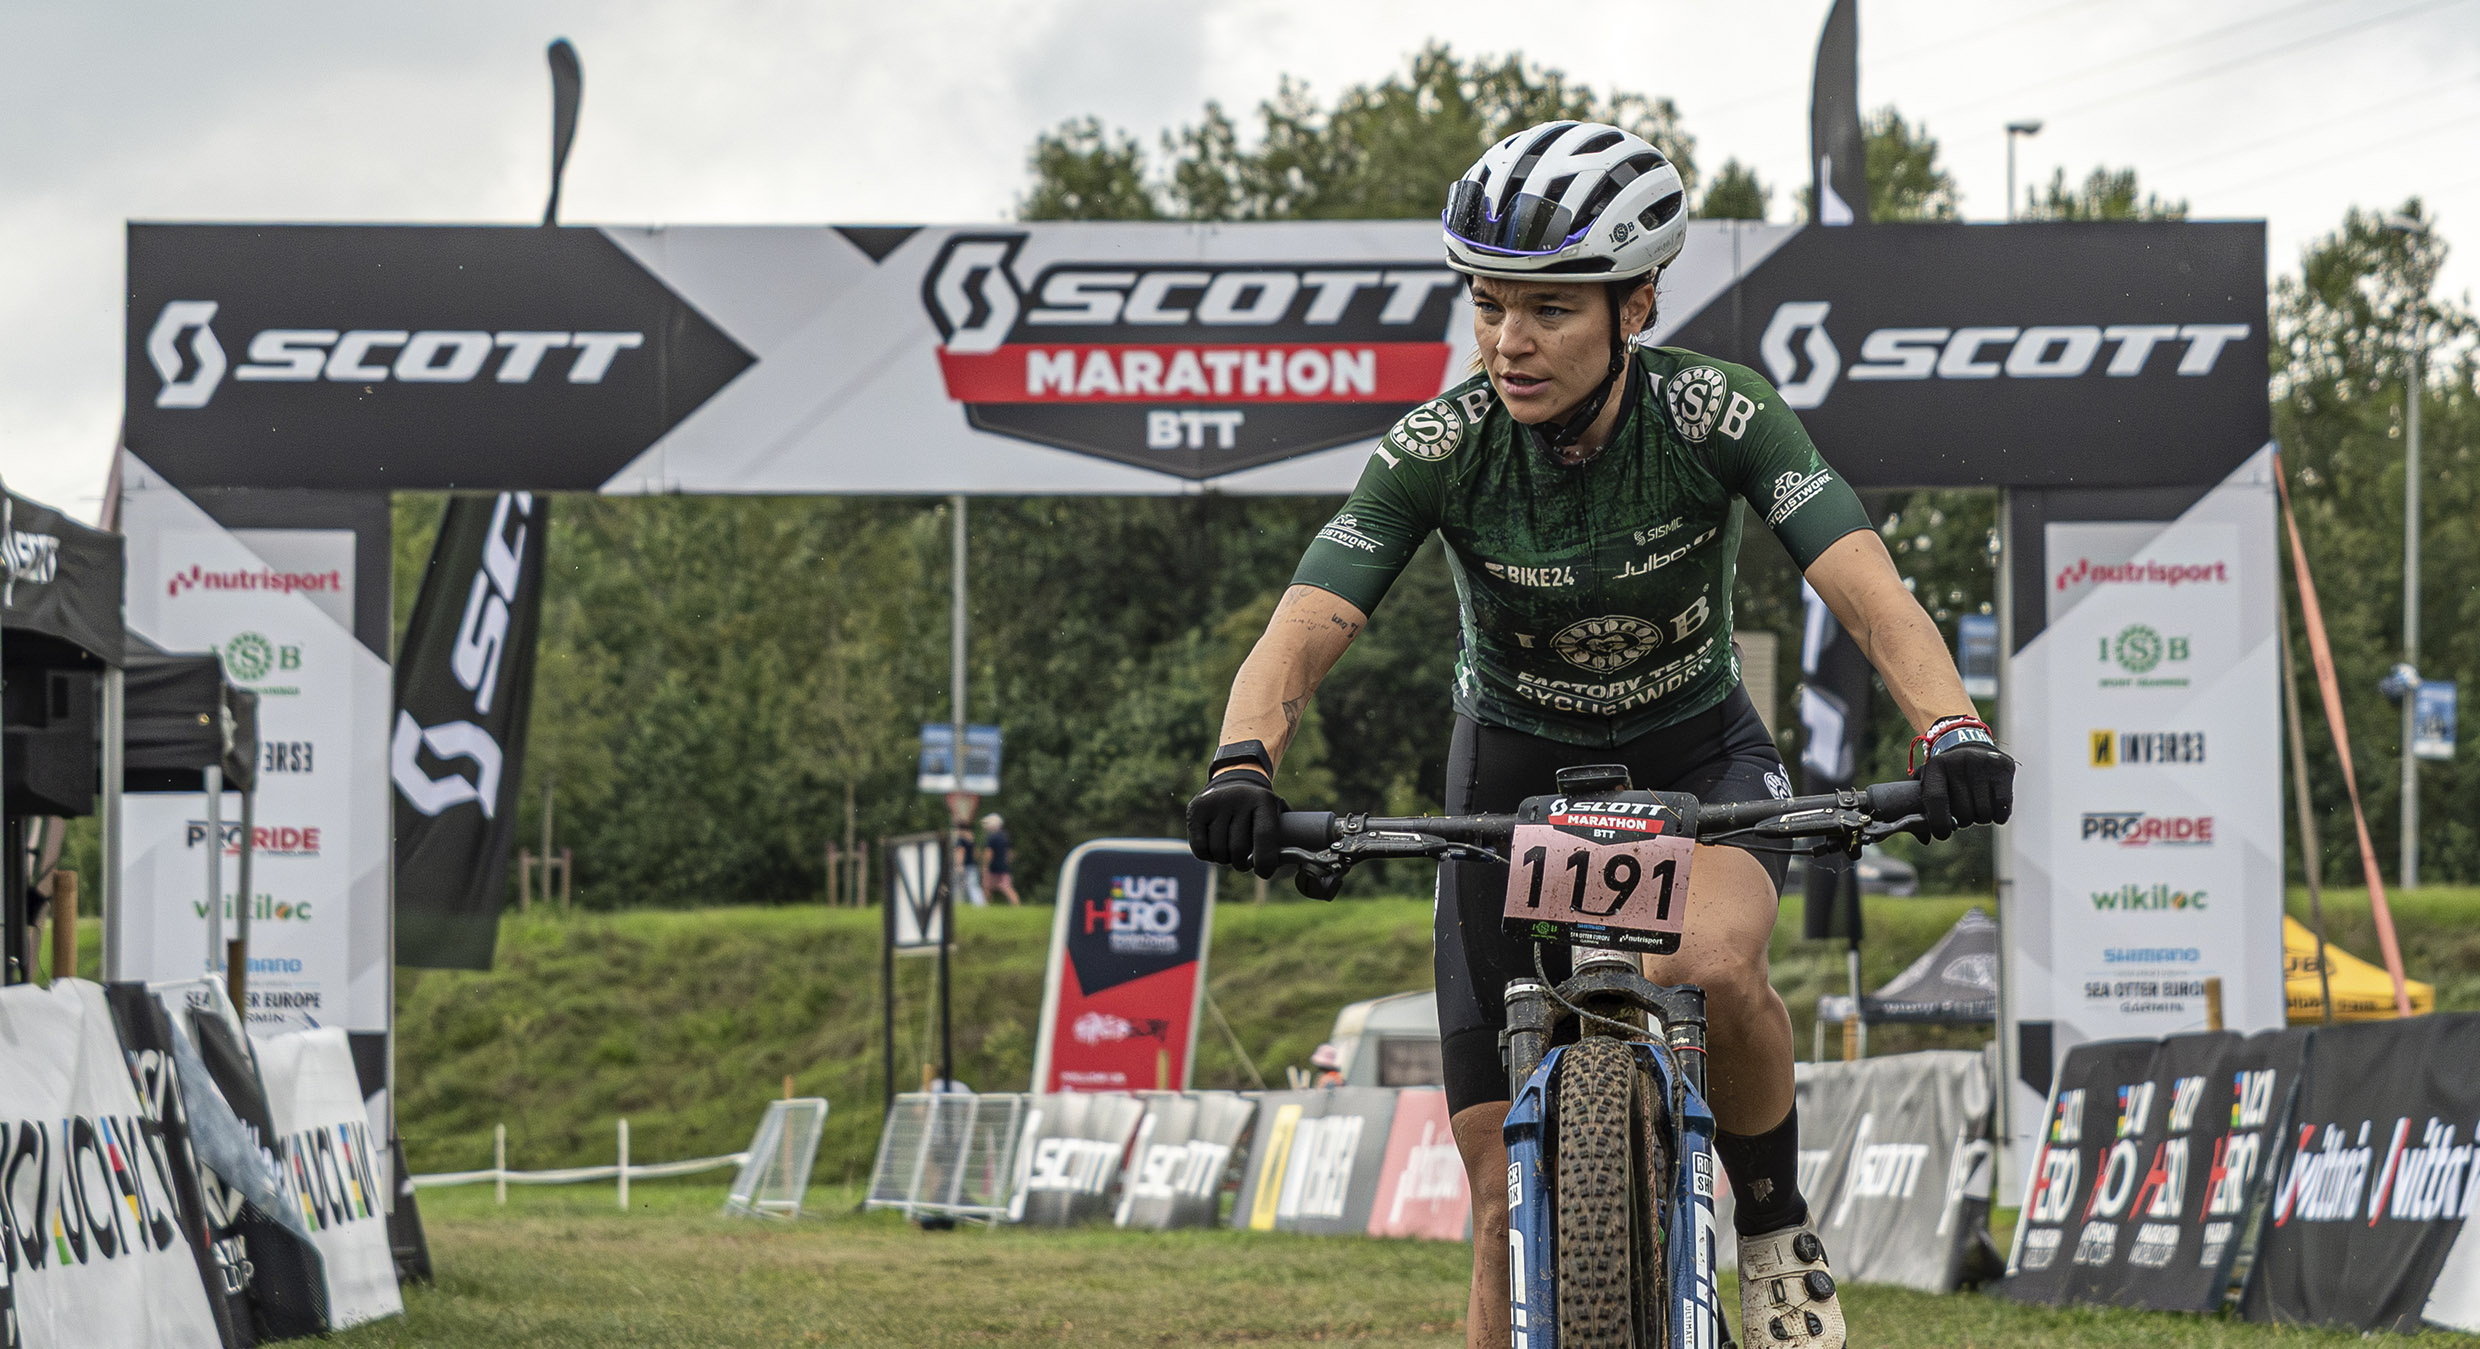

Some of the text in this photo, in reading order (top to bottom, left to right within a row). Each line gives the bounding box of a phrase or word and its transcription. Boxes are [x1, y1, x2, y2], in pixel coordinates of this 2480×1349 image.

[1025, 270, 1460, 326] SCOTT
[234, 329, 645, 383] SCOTT
[1847, 323, 2251, 380] SCOTT
[1026, 349, 1377, 396] MARATHON
[1146, 409, 1245, 450] BTT
[1768, 472, 1833, 529] CYCLISTWORK
[1647, 516, 1683, 542] SISMIC
[1612, 544, 1687, 579] Julbo
[2091, 560, 2228, 588] nutrisport
[203, 567, 341, 593] nutrisport
[1507, 565, 1575, 588] BIKE24
[1518, 637, 1714, 699] FACTORY TEAM
[1569, 801, 1667, 816] SCOTT
[1567, 815, 1647, 831] MARATHON
[1593, 828, 1616, 839] BTT
[185, 823, 322, 853] PORIDE
[1123, 876, 1179, 899] UCI
[1523, 845, 1677, 921] 1191
[2090, 884, 2209, 910] wikiloc
[193, 894, 313, 921] iiloc
[1084, 898, 1181, 935] HERO
[1628, 935, 1663, 945] nutrisport
[265, 991, 322, 1008] EUROPE
[2084, 981, 2110, 998] SEA
[2162, 981, 2206, 998] EURO
[1684, 1305, 1693, 1346] ULTIMATE
